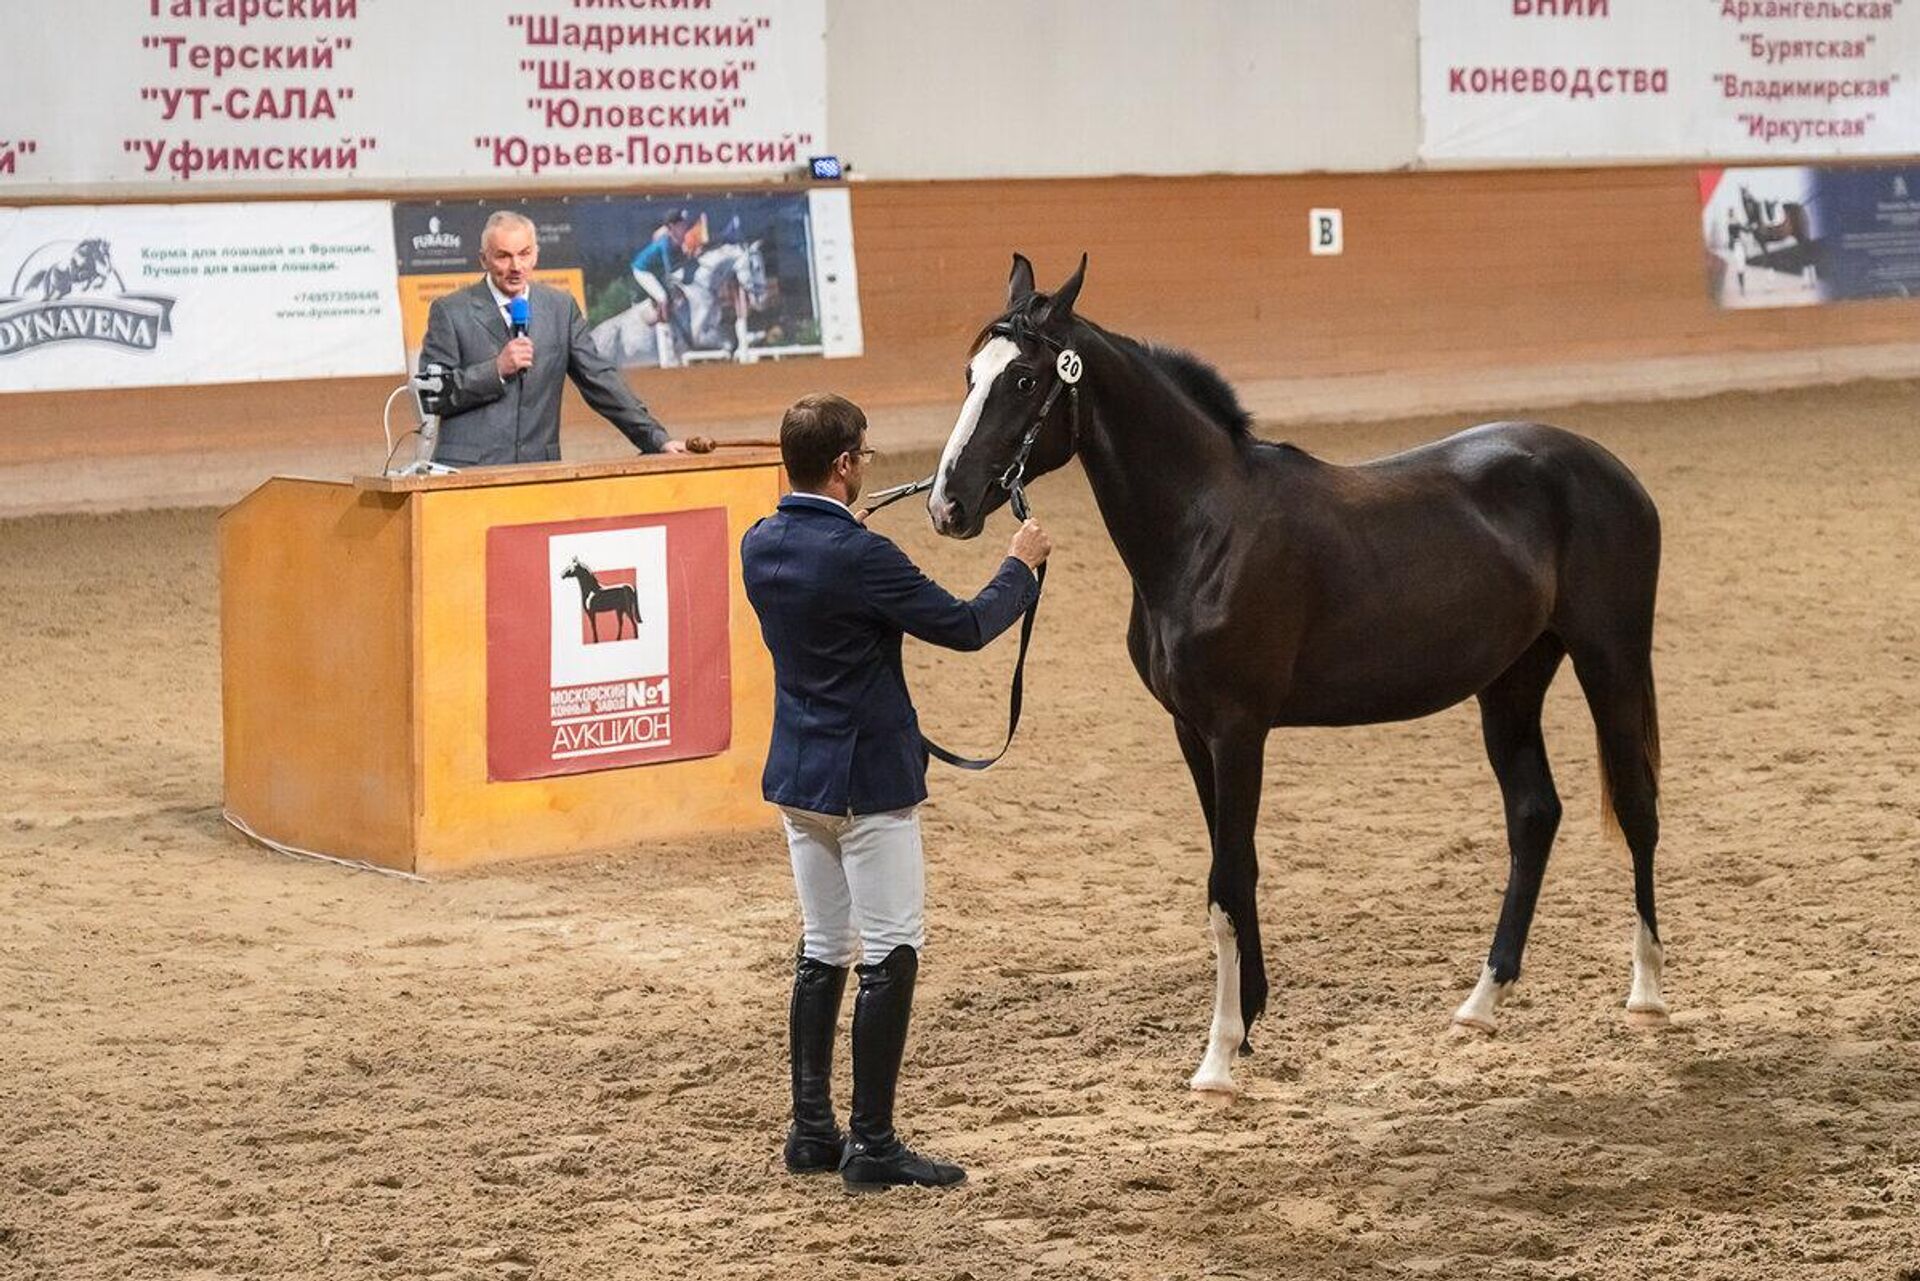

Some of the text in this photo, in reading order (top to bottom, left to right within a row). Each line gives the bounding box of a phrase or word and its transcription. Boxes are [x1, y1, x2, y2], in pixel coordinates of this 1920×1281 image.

[507, 15, 771, 54] "Шадринский"
[1739, 34, 1877, 64] "Бурятская"
[141, 36, 353, 76] "Терский"
[519, 60, 756, 91] "Шаховской"
[1448, 65, 1669, 99] коневодства
[1713, 73, 1900, 102] "Владимирская"
[140, 87, 355, 121] "УТ-САЛА"
[527, 98, 746, 130] "Юловский"
[1738, 113, 1876, 144] "Иркутская"
[122, 138, 377, 179] "Уфимский"
[474, 134, 813, 173] "Юрьев-Польский"
[1319, 217, 1334, 246] B
[140, 247, 188, 261] Корма
[0, 307, 154, 350] DYNAVENA
[1060, 354, 1080, 378] 20
[551, 683, 626, 705] МОСКОВСКИЙ
[552, 713, 671, 753] АУКЦИОН
